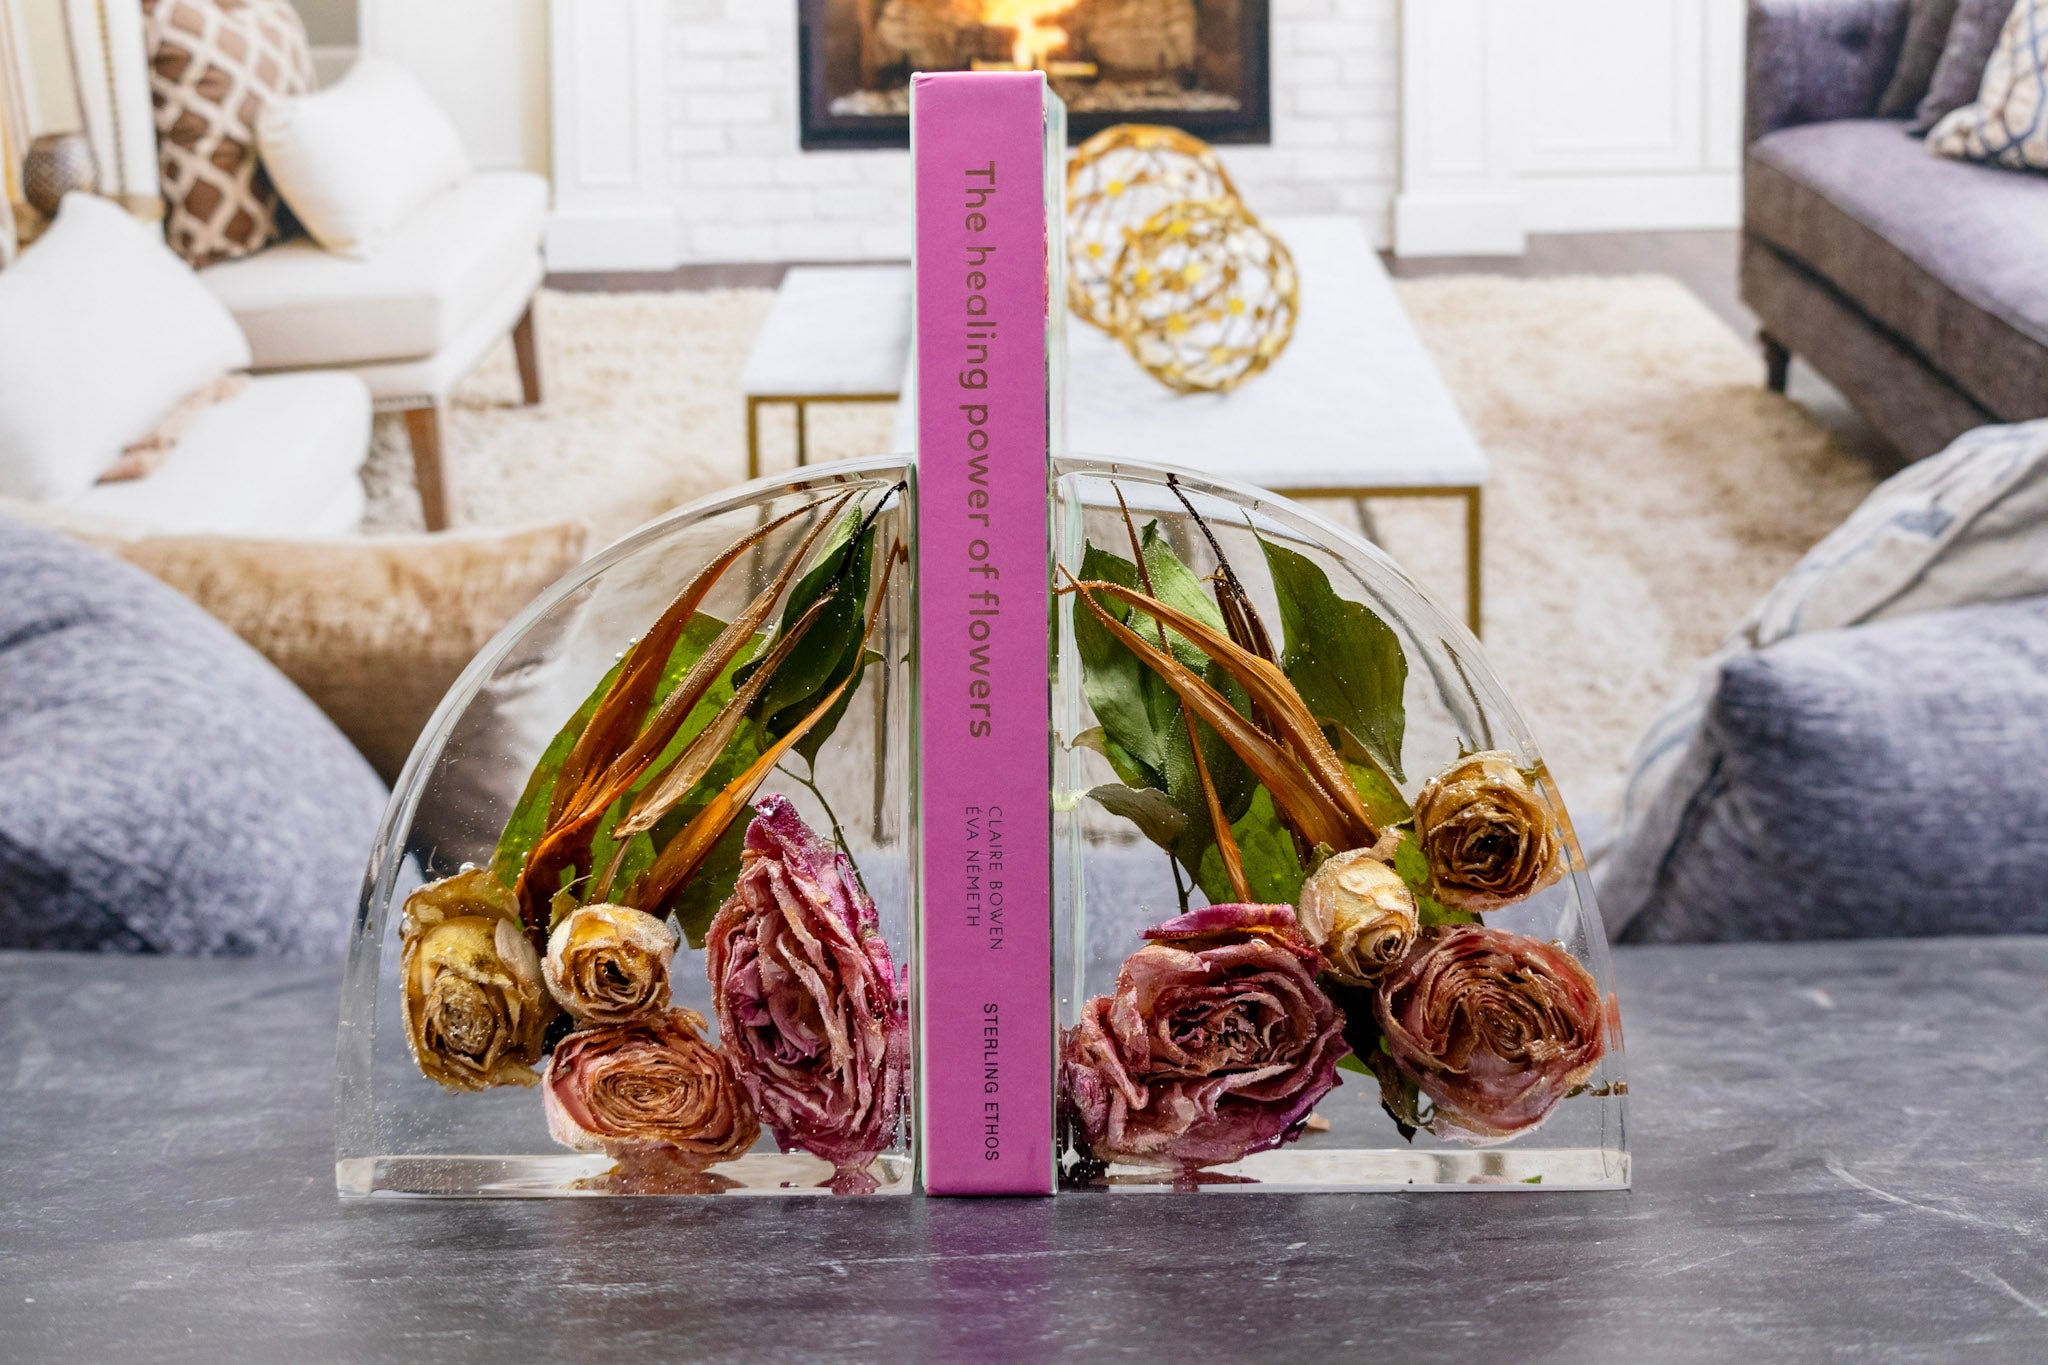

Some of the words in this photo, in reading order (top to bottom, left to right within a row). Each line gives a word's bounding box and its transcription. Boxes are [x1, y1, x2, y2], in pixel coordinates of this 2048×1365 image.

[965, 160, 996, 233] The
[959, 246, 997, 390] healing
[959, 404, 989, 528] power
[968, 539, 1000, 580] of
[968, 590, 1000, 738] flowers
[965, 806, 983, 841] ÉVA
[988, 806, 1003, 871] CLAIRE
[966, 850, 983, 927] NÉMETH
[989, 880, 1004, 950] BOWEN
[983, 1003, 999, 1094] STERLING
[984, 1102, 1000, 1161] ETHOS
